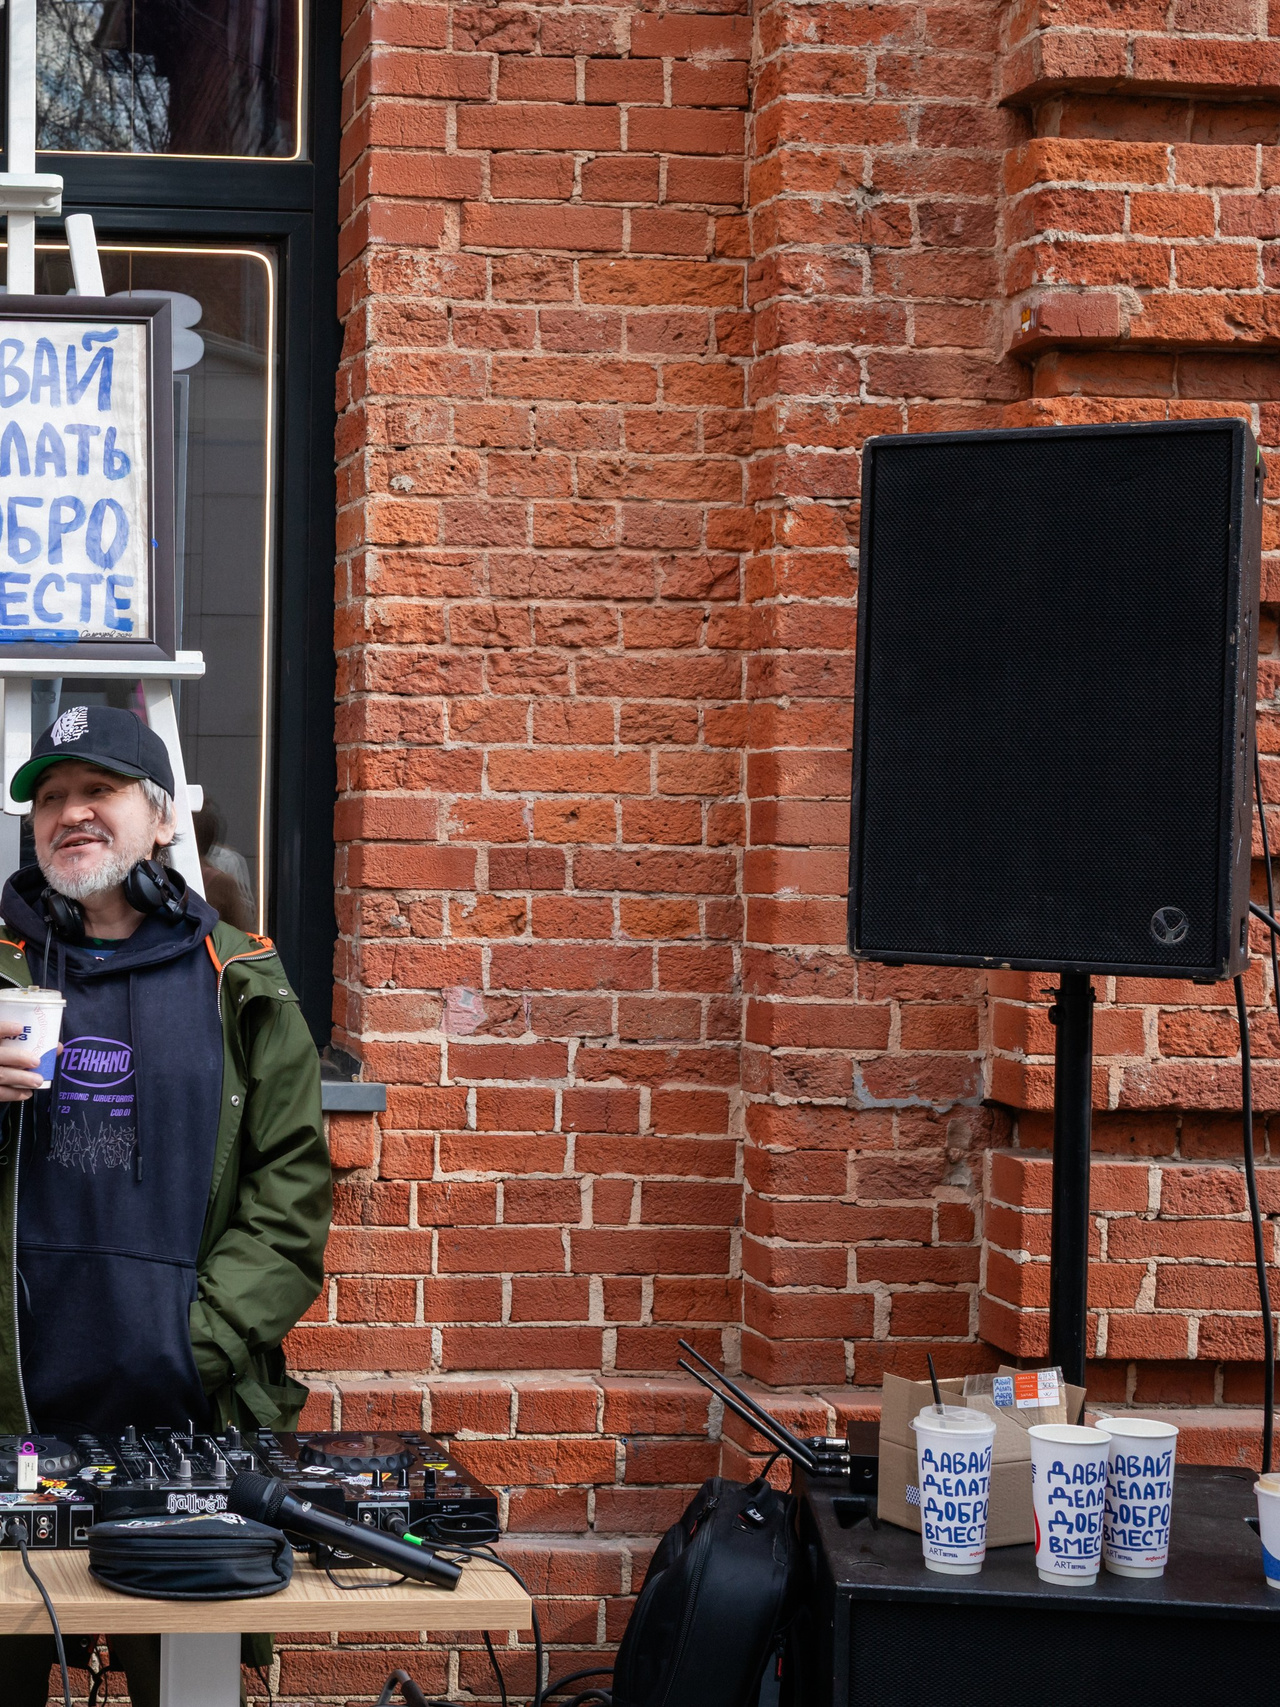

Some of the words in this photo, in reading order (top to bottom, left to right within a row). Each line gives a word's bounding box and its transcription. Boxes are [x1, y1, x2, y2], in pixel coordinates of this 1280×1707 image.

[61, 1048, 131, 1072] TEKKKNO
[60, 1092, 90, 1101] ECTRONIC
[92, 1094, 134, 1102] WAVEFORMS
[922, 1445, 992, 1475] ДАВАЙ
[1048, 1487, 1104, 1508] ДЕЛА
[925, 1522, 988, 1543] ВМЕСТ
[1049, 1535, 1101, 1555] ВМЕС
